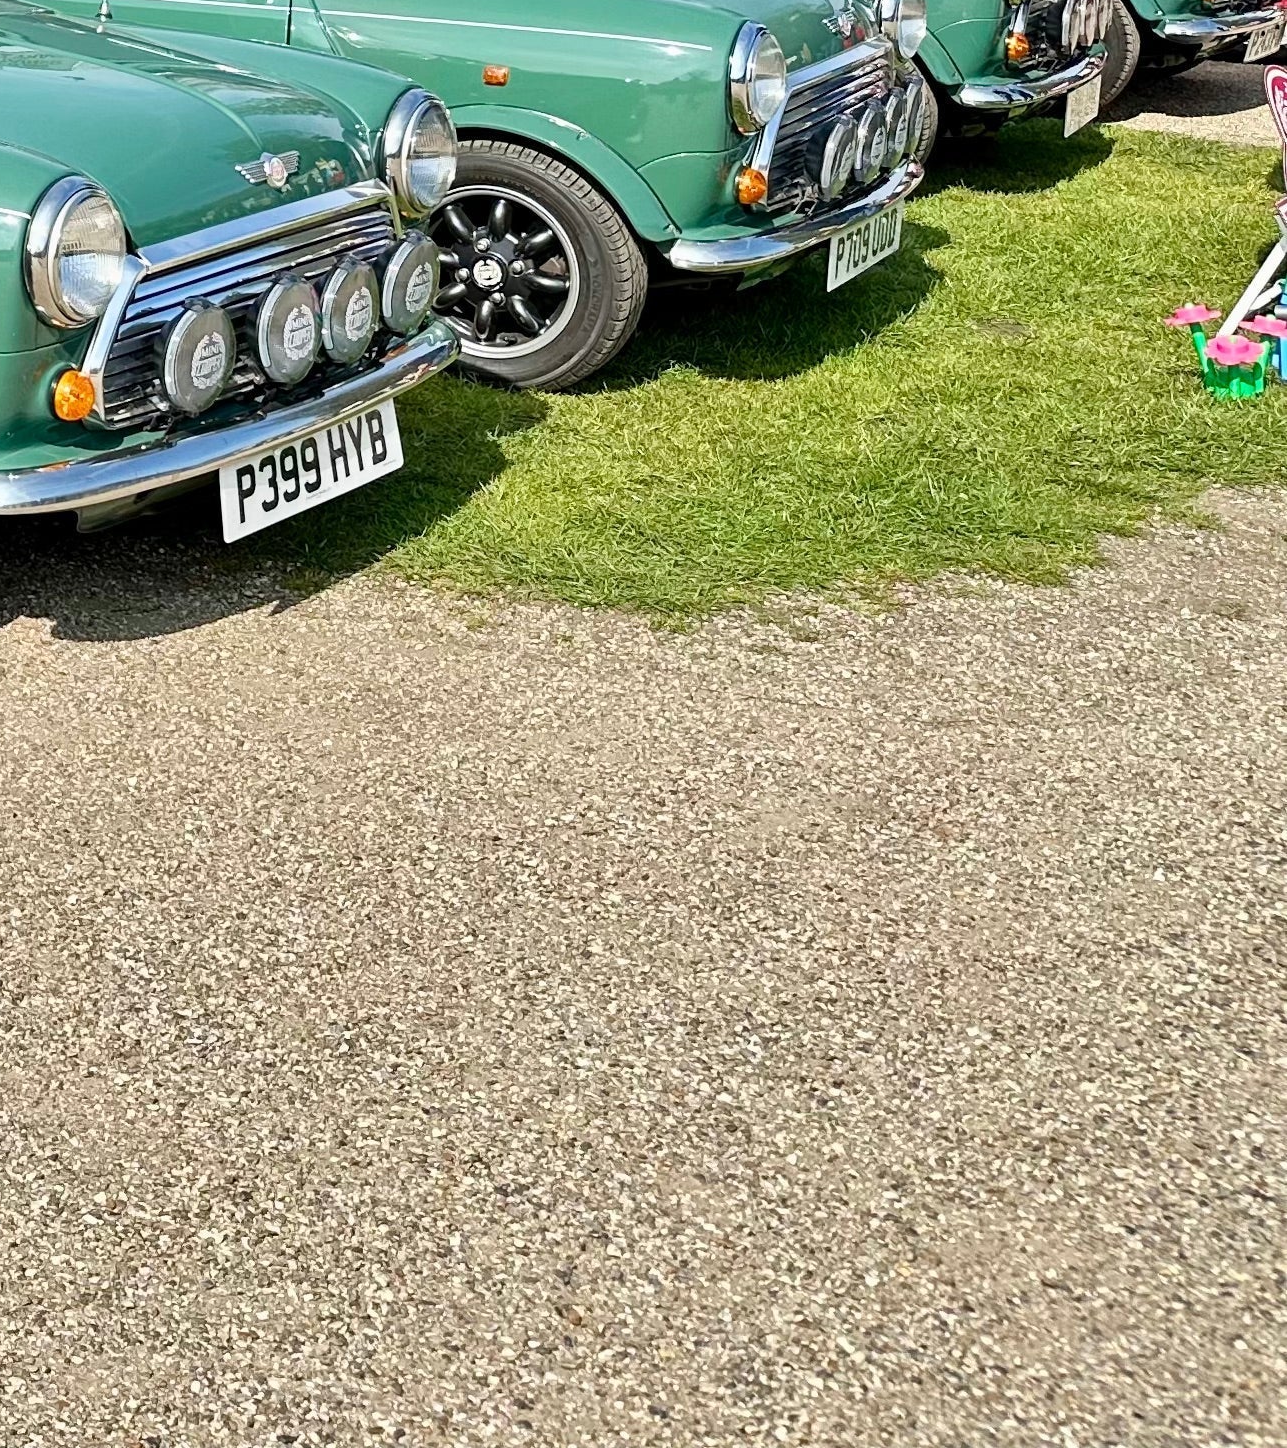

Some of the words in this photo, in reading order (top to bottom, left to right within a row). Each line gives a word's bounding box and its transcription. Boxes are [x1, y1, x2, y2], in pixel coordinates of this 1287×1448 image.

[834, 223, 871, 280] P709
[235, 436, 322, 525] P399
[326, 409, 388, 484] HYB
